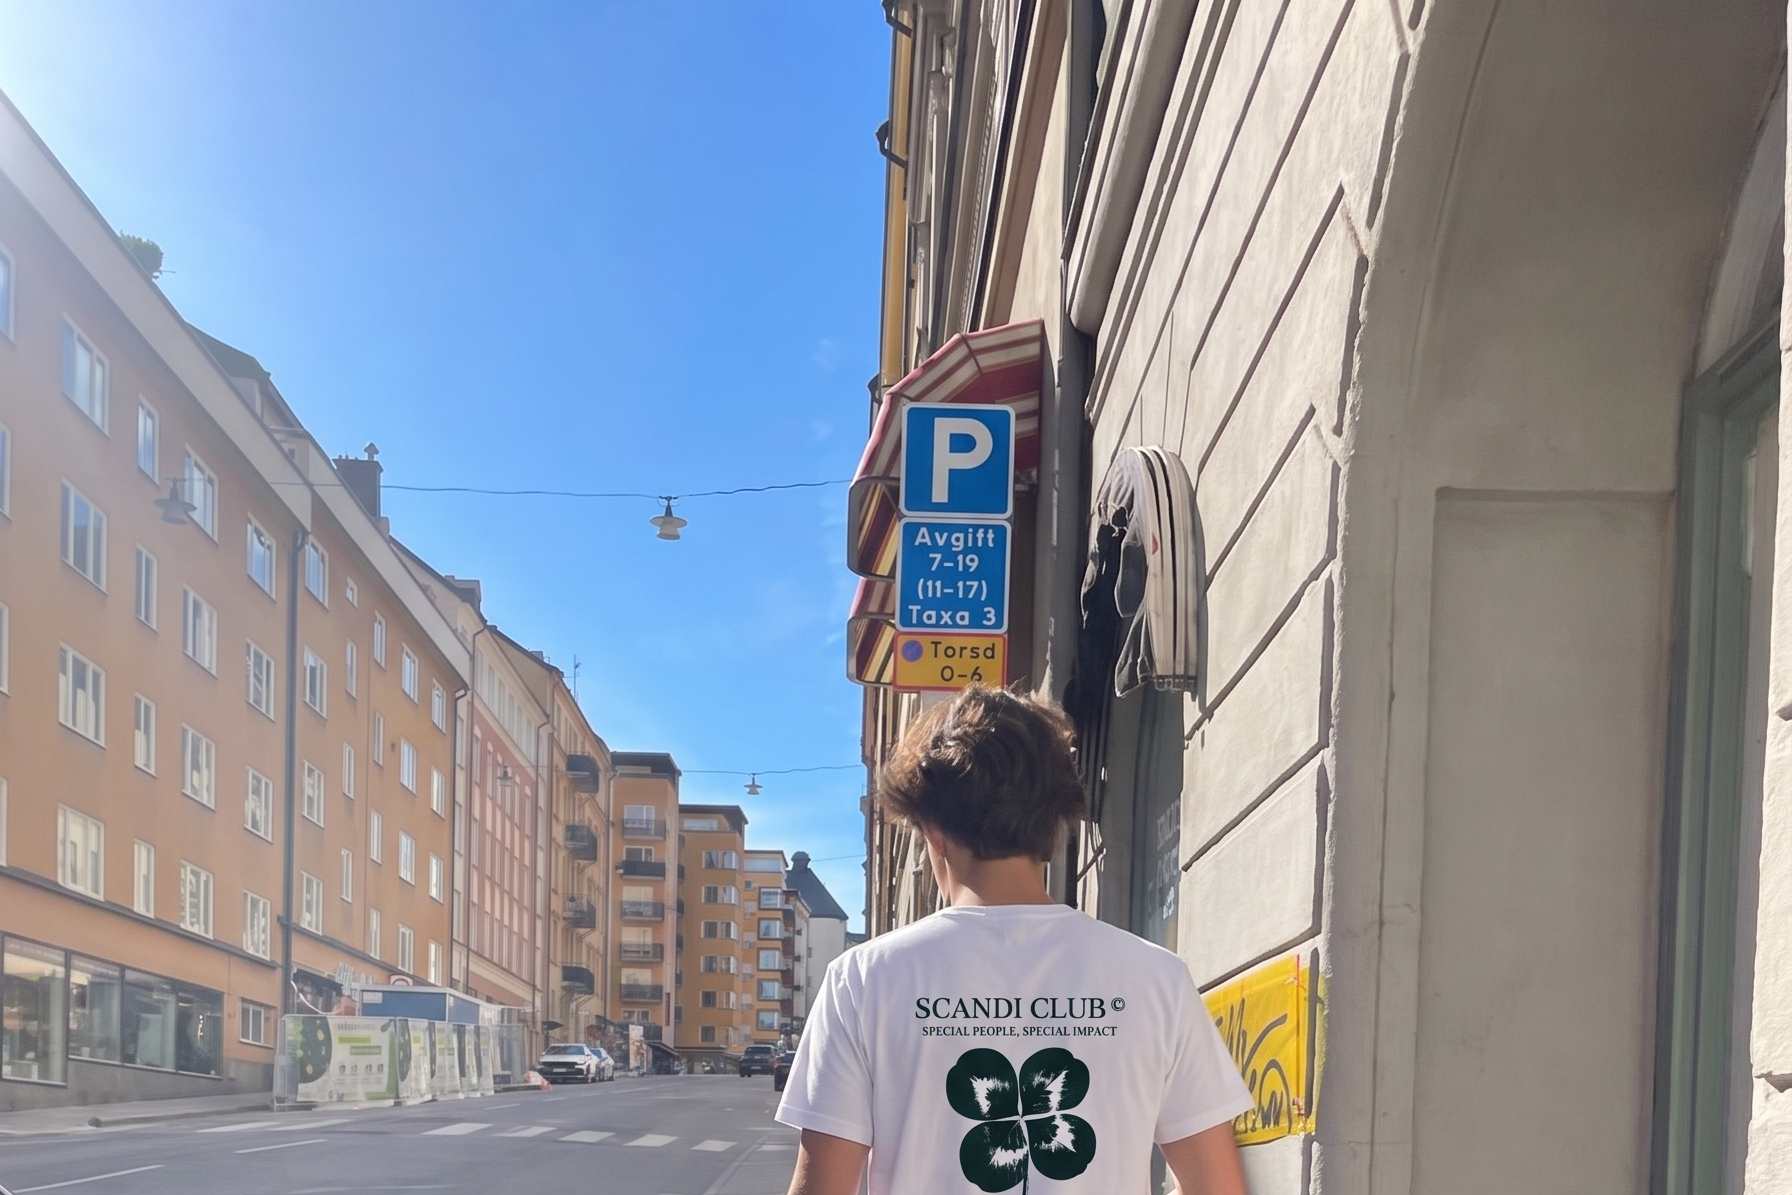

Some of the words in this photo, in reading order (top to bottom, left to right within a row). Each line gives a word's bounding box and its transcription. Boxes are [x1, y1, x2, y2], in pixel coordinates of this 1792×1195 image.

[931, 417, 993, 503] P
[914, 527, 995, 551] Avgift
[929, 553, 979, 572] 7-19
[917, 579, 987, 601] (11-17)
[908, 605, 970, 626] Taxa
[982, 606, 996, 626] 3
[931, 641, 996, 660] Torsd
[940, 665, 983, 682] 0-6
[914, 997, 1023, 1019] SCANDI
[922, 1026, 970, 1037] SPECIAL
[972, 1026, 1020, 1038] PEOPLE,
[1022, 1026, 1071, 1037] SPECIAL
[1072, 1026, 1118, 1037] IMPACT
